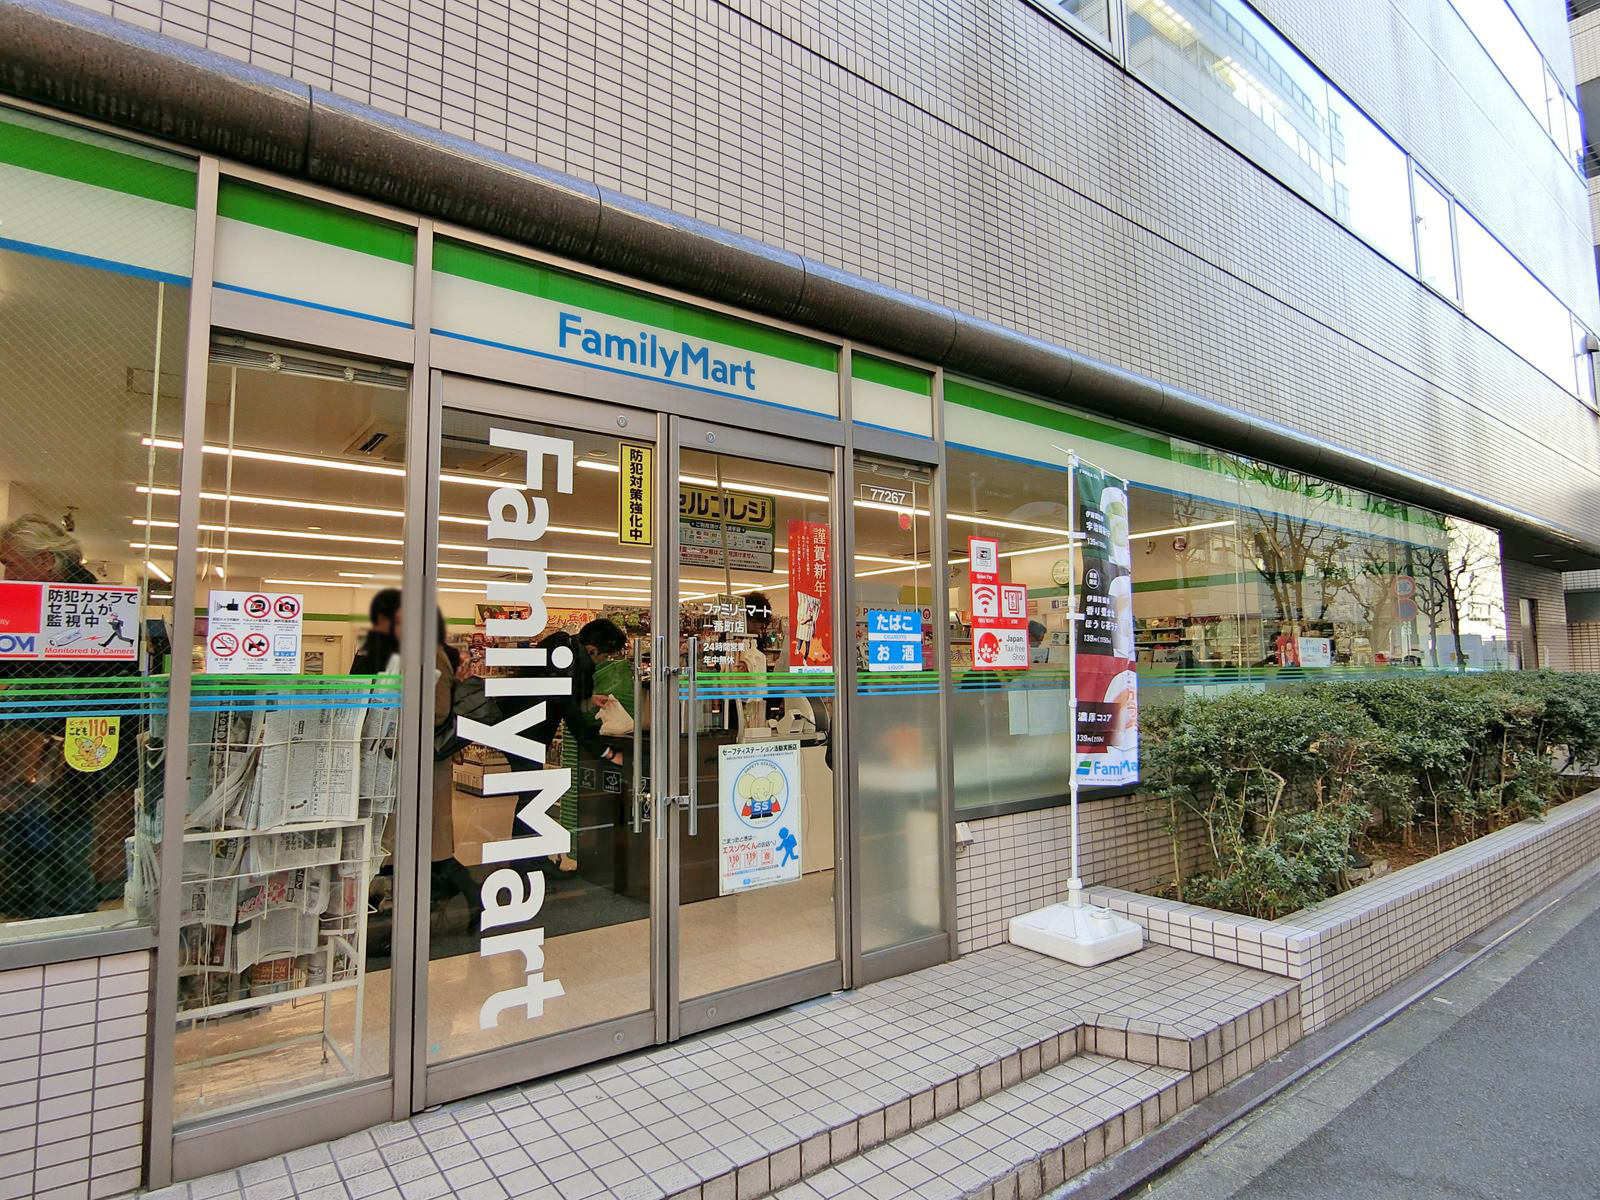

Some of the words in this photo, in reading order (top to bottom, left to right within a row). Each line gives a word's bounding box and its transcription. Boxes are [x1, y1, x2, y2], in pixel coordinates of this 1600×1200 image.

[559, 311, 756, 390] FamilyMart
[629, 448, 644, 541] 防犯対策強化中
[870, 488, 905, 504] 77267
[813, 527, 827, 597] 謹賀新年
[47, 589, 138, 604] 防犯カメラで
[48, 603, 113, 616] セコムが
[703, 603, 773, 618] ファミリーマート
[46, 614, 99, 628] 監視中
[703, 620, 745, 632] 一番町店
[877, 613, 913, 631] たばこ
[703, 642, 744, 651] 24時間営業
[703, 655, 735, 665] 年中無休
[1012, 652, 1025, 660] Shop
[1078, 712, 1112, 722] 濃厚ココア
[456, 427, 575, 1031] FamilyMart
[754, 801, 769, 812] SS
